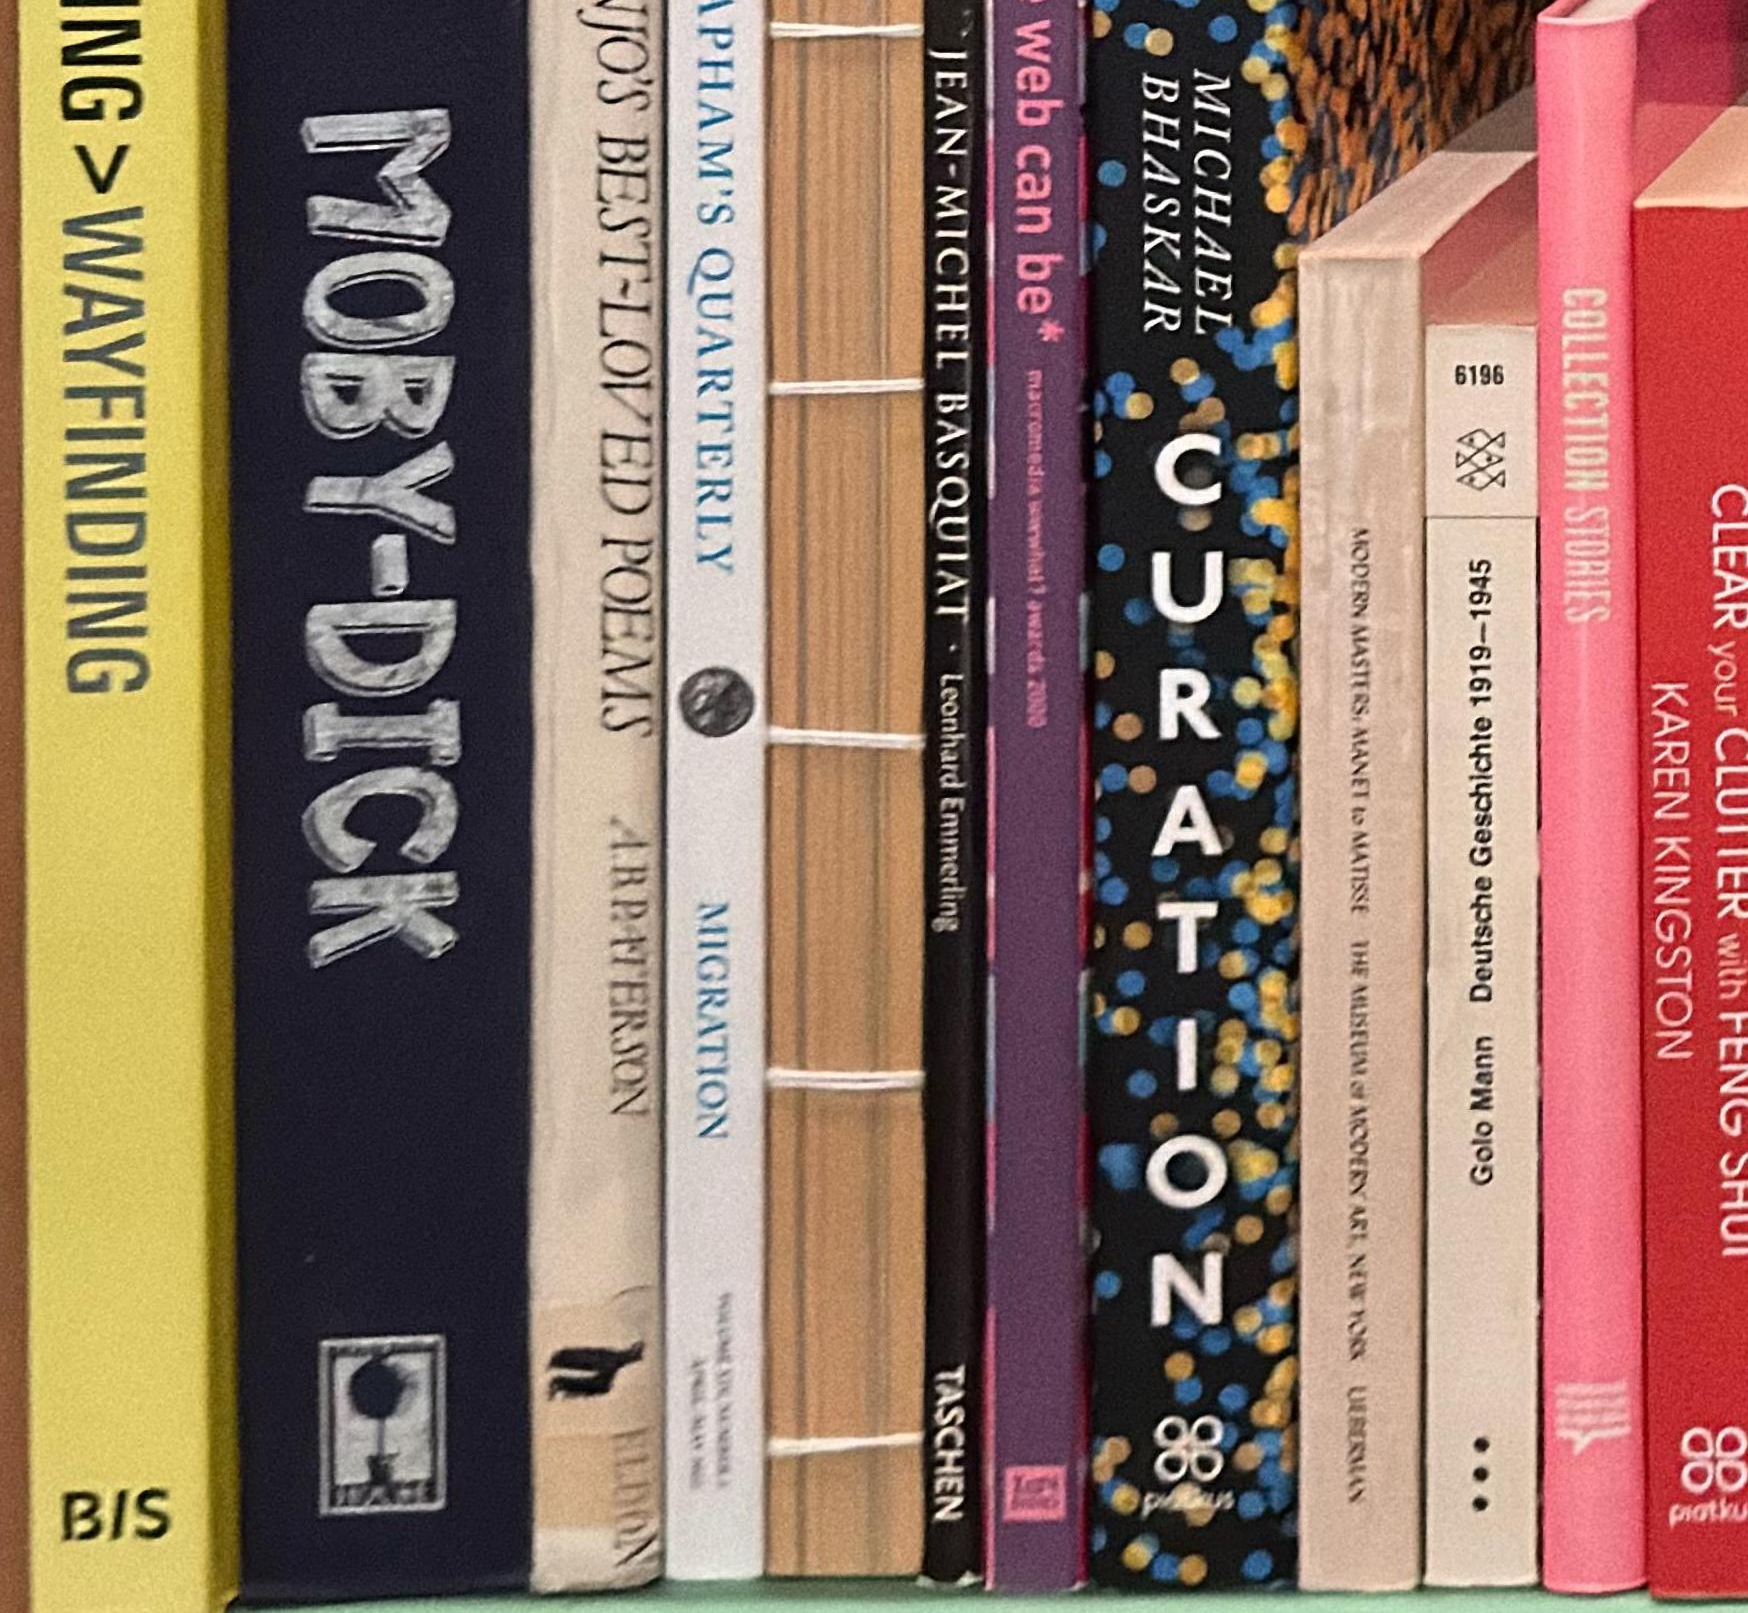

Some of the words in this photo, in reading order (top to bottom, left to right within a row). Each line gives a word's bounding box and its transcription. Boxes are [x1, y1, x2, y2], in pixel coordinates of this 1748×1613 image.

[1016, 20, 1065, 127] web
[928, 48, 972, 370] JEAN-MICHEL
[1016, 146, 1053, 235] can
[1142, 72, 1181, 335] BHASKAR
[1193, 68, 1233, 336] MICHAEL
[597, 133, 654, 517] BEST-LOVED
[1455, 365, 1505, 385] 6196
[1560, 287, 1611, 492] COLLECTION
[61, 206, 151, 695] WAYFINDING
[686, 247, 736, 574] QUARTERLY
[300, 108, 462, 970] MOBY-DICK
[928, 391, 972, 622] BASQUIAT
[1564, 506, 1612, 625] STORIES
[1350, 527, 1371, 619] MODERN
[600, 539, 655, 739] POEMS
[1708, 642, 1738, 717] your
[939, 672, 968, 793] Leonhard
[1350, 726, 1371, 798] MANET
[1469, 712, 1493, 868] Geschichte
[1652, 682, 1691, 820] KAREN
[931, 798, 968, 934] Emmerling
[1146, 433, 1228, 1327] CURATION
[1350, 830, 1371, 914] MATISSE
[1351, 806, 1369, 826] to
[1349, 939, 1370, 978] THE
[1470, 877, 1493, 1002] Deutsche
[1655, 836, 1693, 1061] KINGSTON
[1717, 932, 1748, 1000] with
[696, 900, 731, 1141] MIGRATION
[1349, 984, 1370, 1076] MUSEUM
[1471, 1036, 1493, 1104] Mann
[1348, 1105, 1369, 1196] MODERN
[1471, 1117, 1494, 1186] Golo
[934, 1364, 966, 1523] TASCHEN
